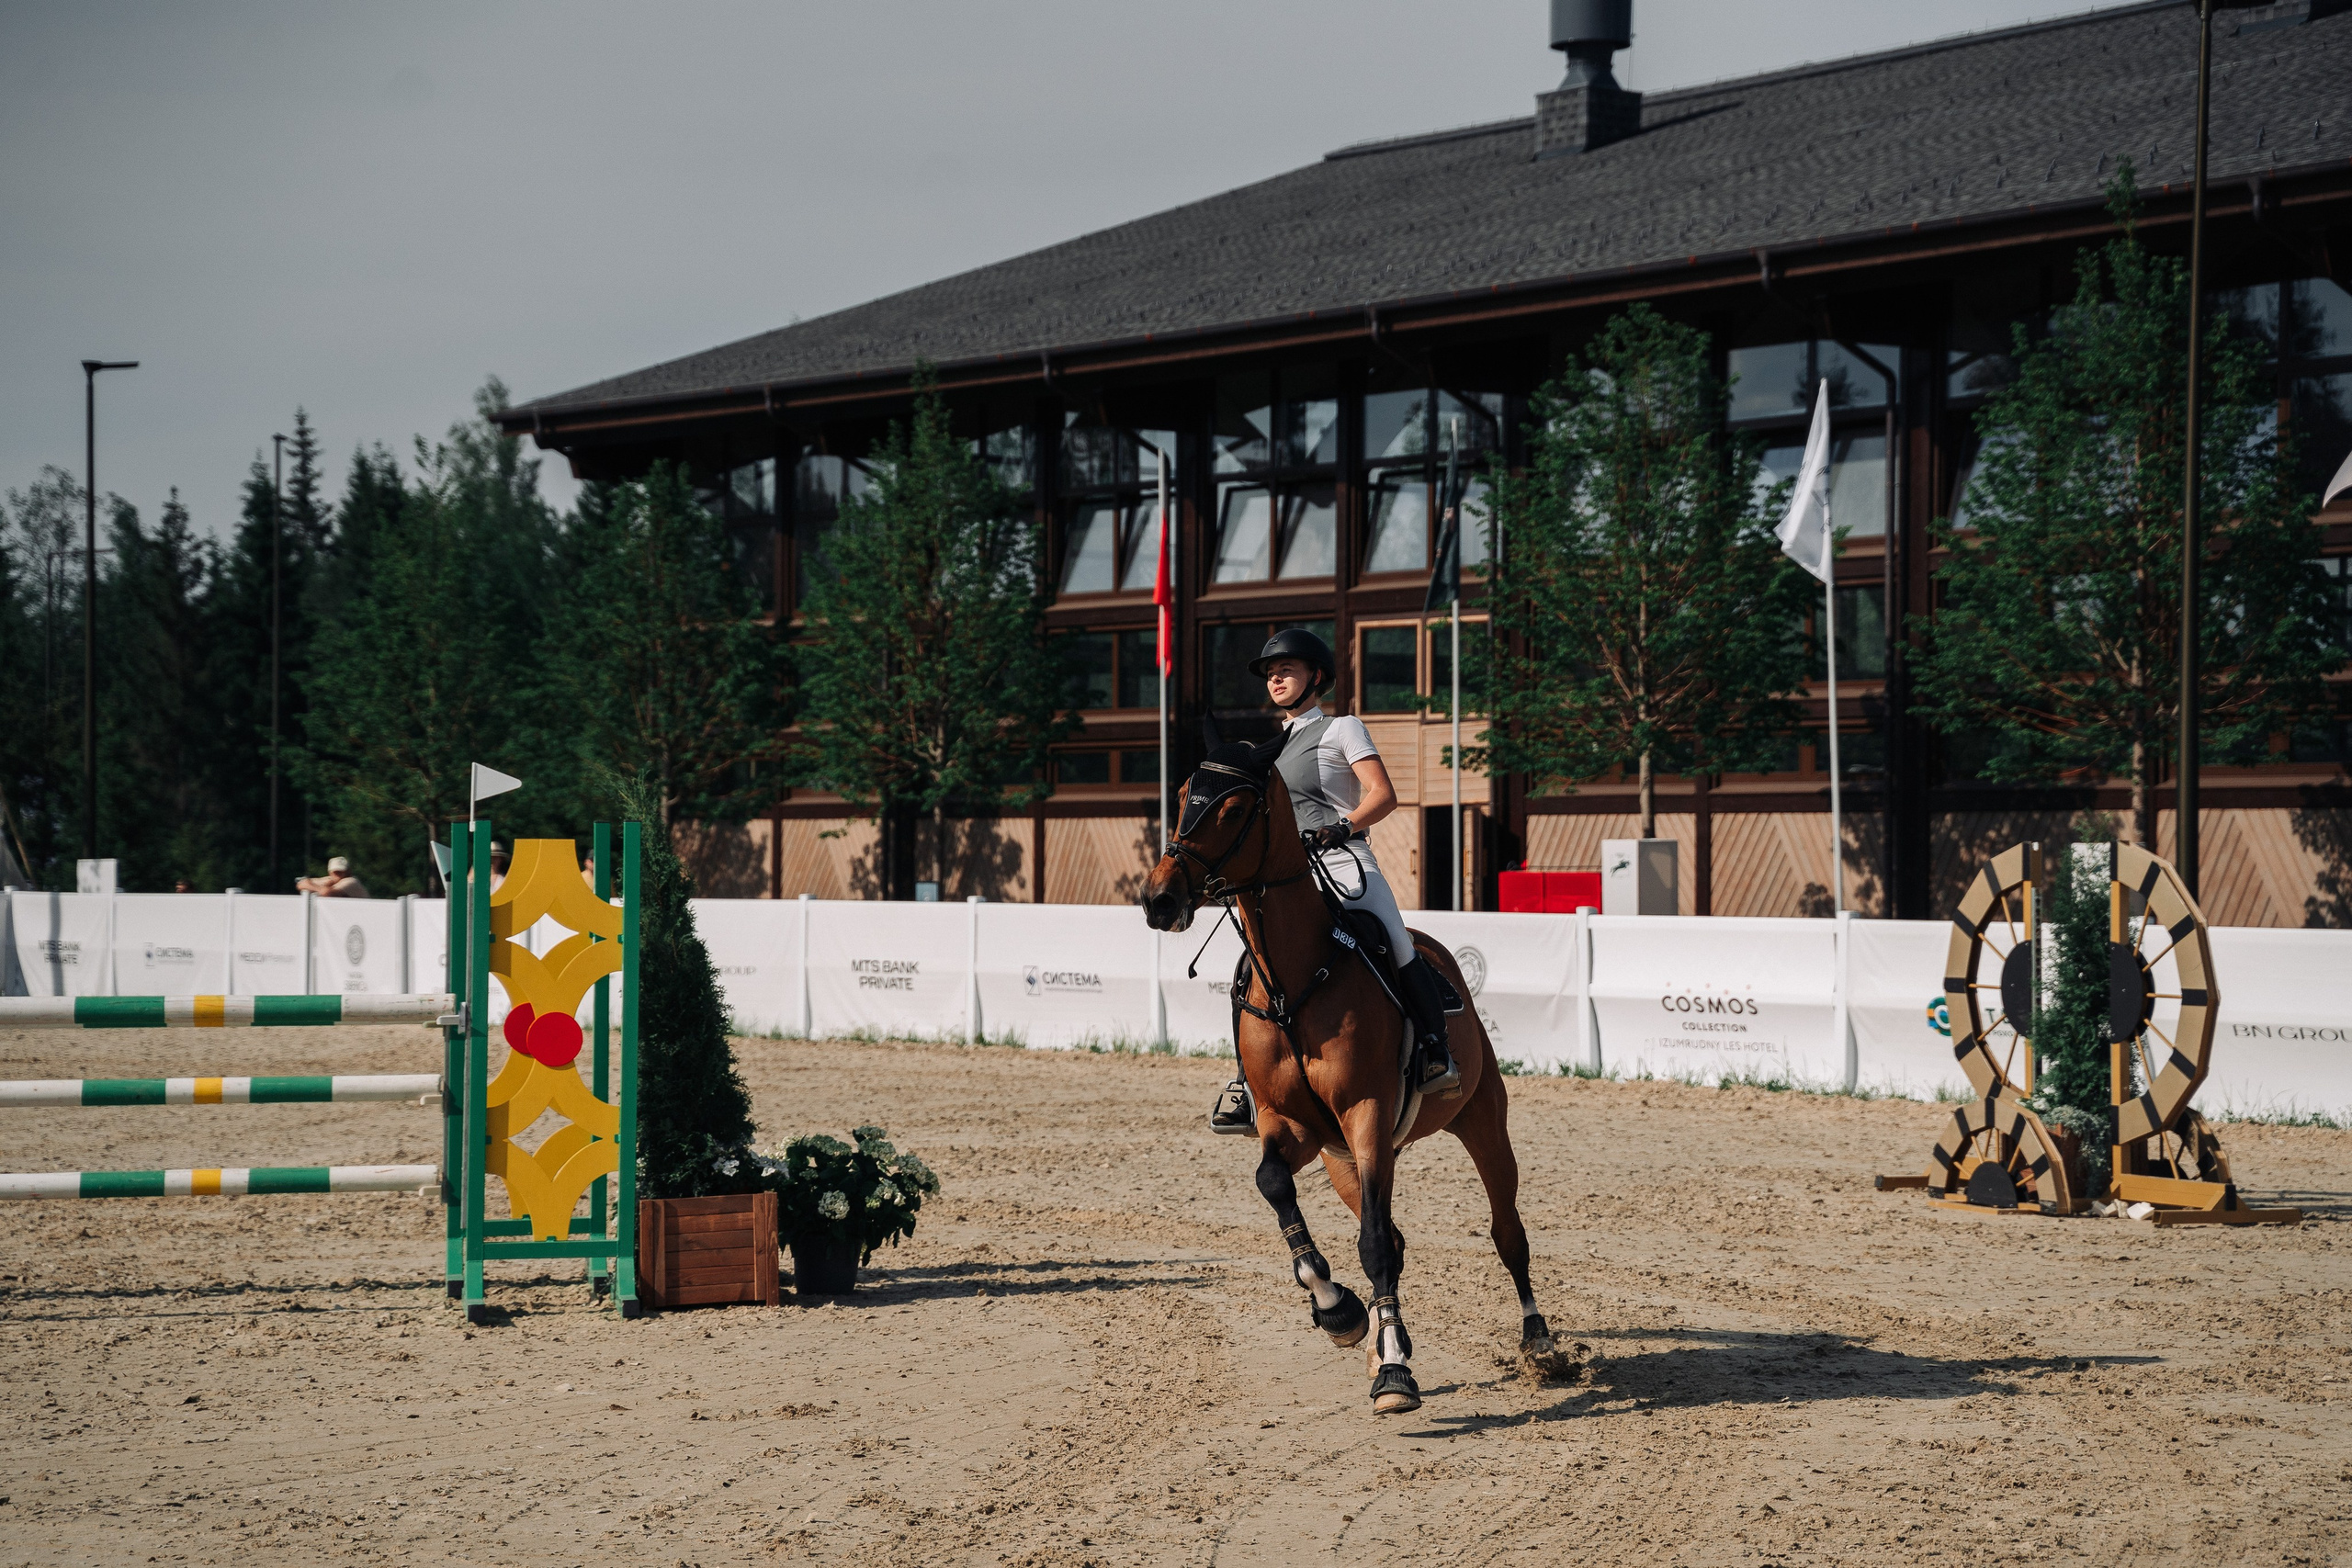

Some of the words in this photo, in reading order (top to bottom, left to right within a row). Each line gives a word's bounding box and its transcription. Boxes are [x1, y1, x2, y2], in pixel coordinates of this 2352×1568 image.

[1190, 795, 1210, 804] PRIME
[719, 965, 756, 976] ROUP
[851, 959, 879, 973] MTS
[882, 960, 920, 975] BANK
[859, 976, 914, 991] PRIVATE
[1042, 971, 1102, 987] СИСТЕМА
[1661, 995, 1758, 1015] COSMOS
[1682, 1021, 1748, 1033] COLLECTION
[2233, 1023, 2272, 1039] BN
[1659, 1037, 1720, 1050] IZUMRUDNY
[1724, 1040, 1741, 1051] LES
[1743, 1042, 1779, 1054] HOTEL
